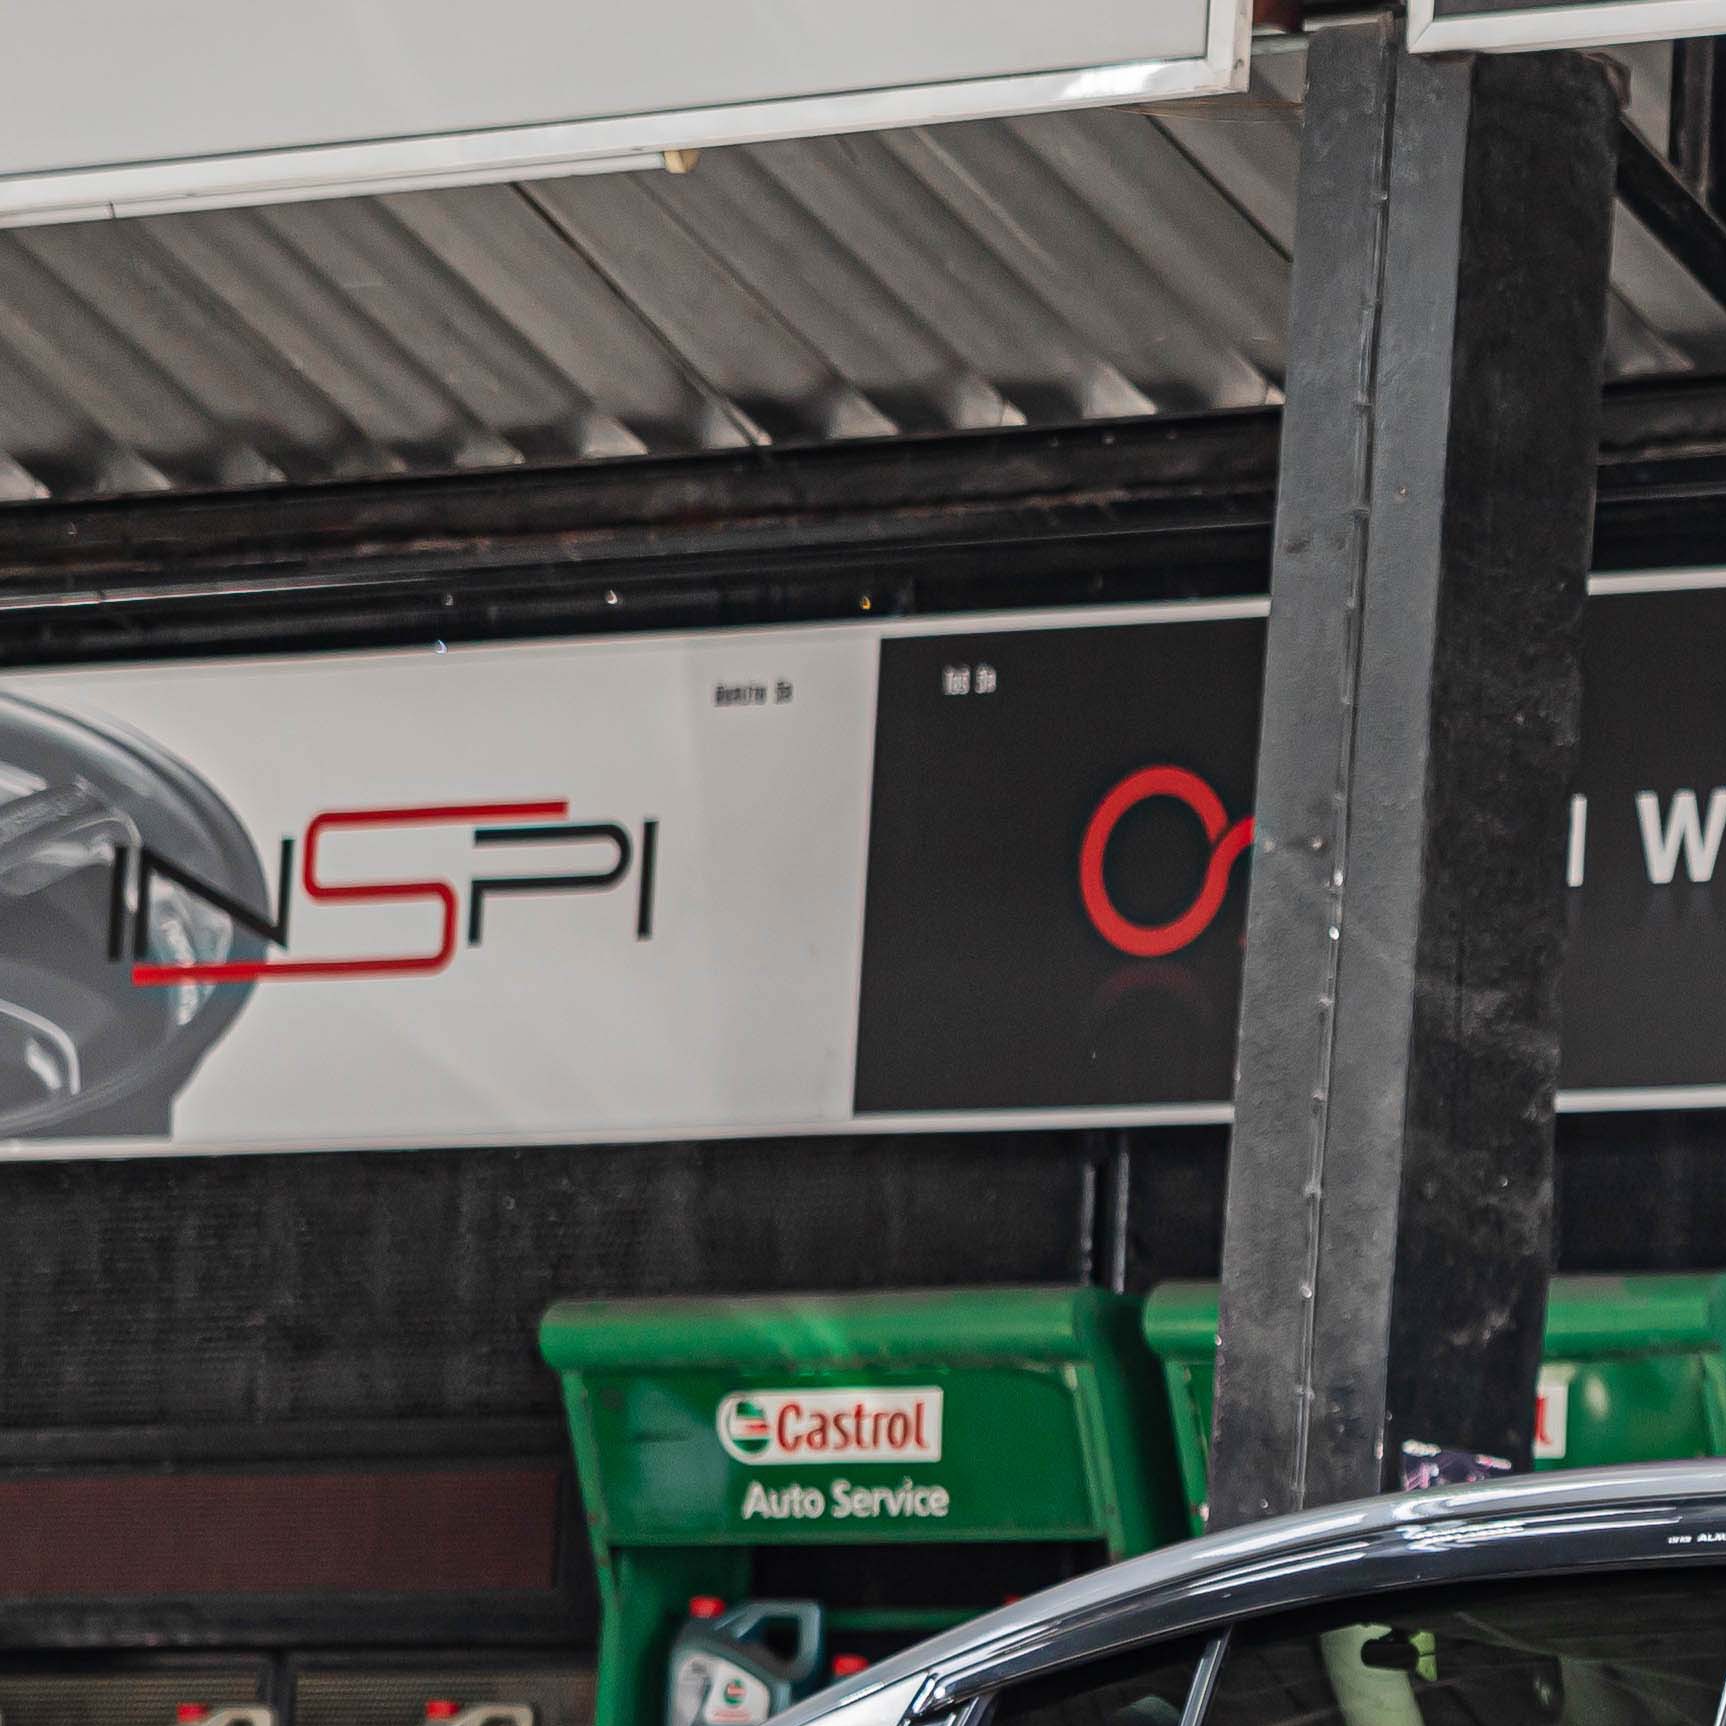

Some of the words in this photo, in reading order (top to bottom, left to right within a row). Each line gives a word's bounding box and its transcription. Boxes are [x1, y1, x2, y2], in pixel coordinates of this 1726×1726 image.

[776, 1401, 929, 1454] Castrol
[741, 1480, 826, 1521] Auto
[830, 1475, 950, 1520] Service
